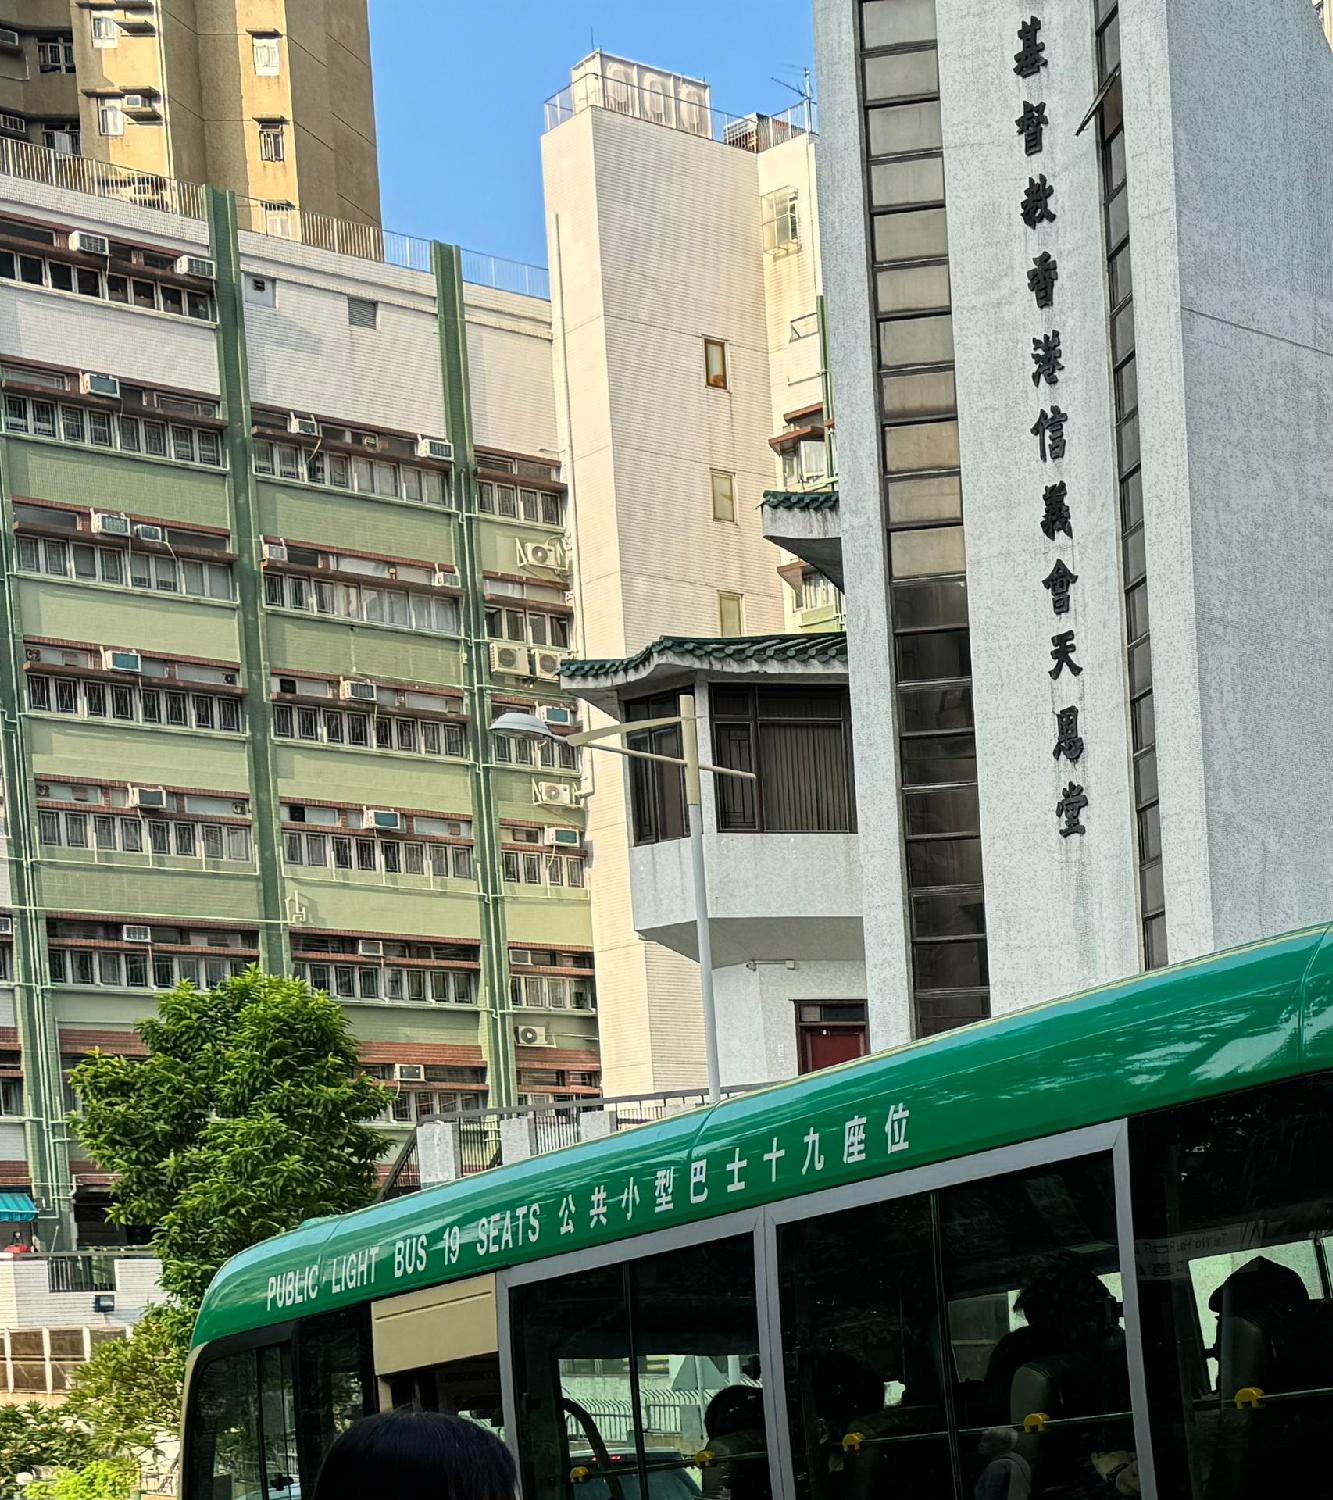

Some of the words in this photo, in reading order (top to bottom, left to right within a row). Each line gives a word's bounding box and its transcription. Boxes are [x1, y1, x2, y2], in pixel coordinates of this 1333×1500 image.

[1012, 14, 1089, 839] 基督教香港信義會天恩堂
[267, 1264, 319, 1312] PUBLIC
[332, 1246, 379, 1294] LIGHT
[394, 1234, 428, 1279] BUS
[443, 1226, 460, 1266] 19
[476, 1202, 541, 1256] SEATS
[557, 1102, 910, 1236] 公共小型巴士十九座位
